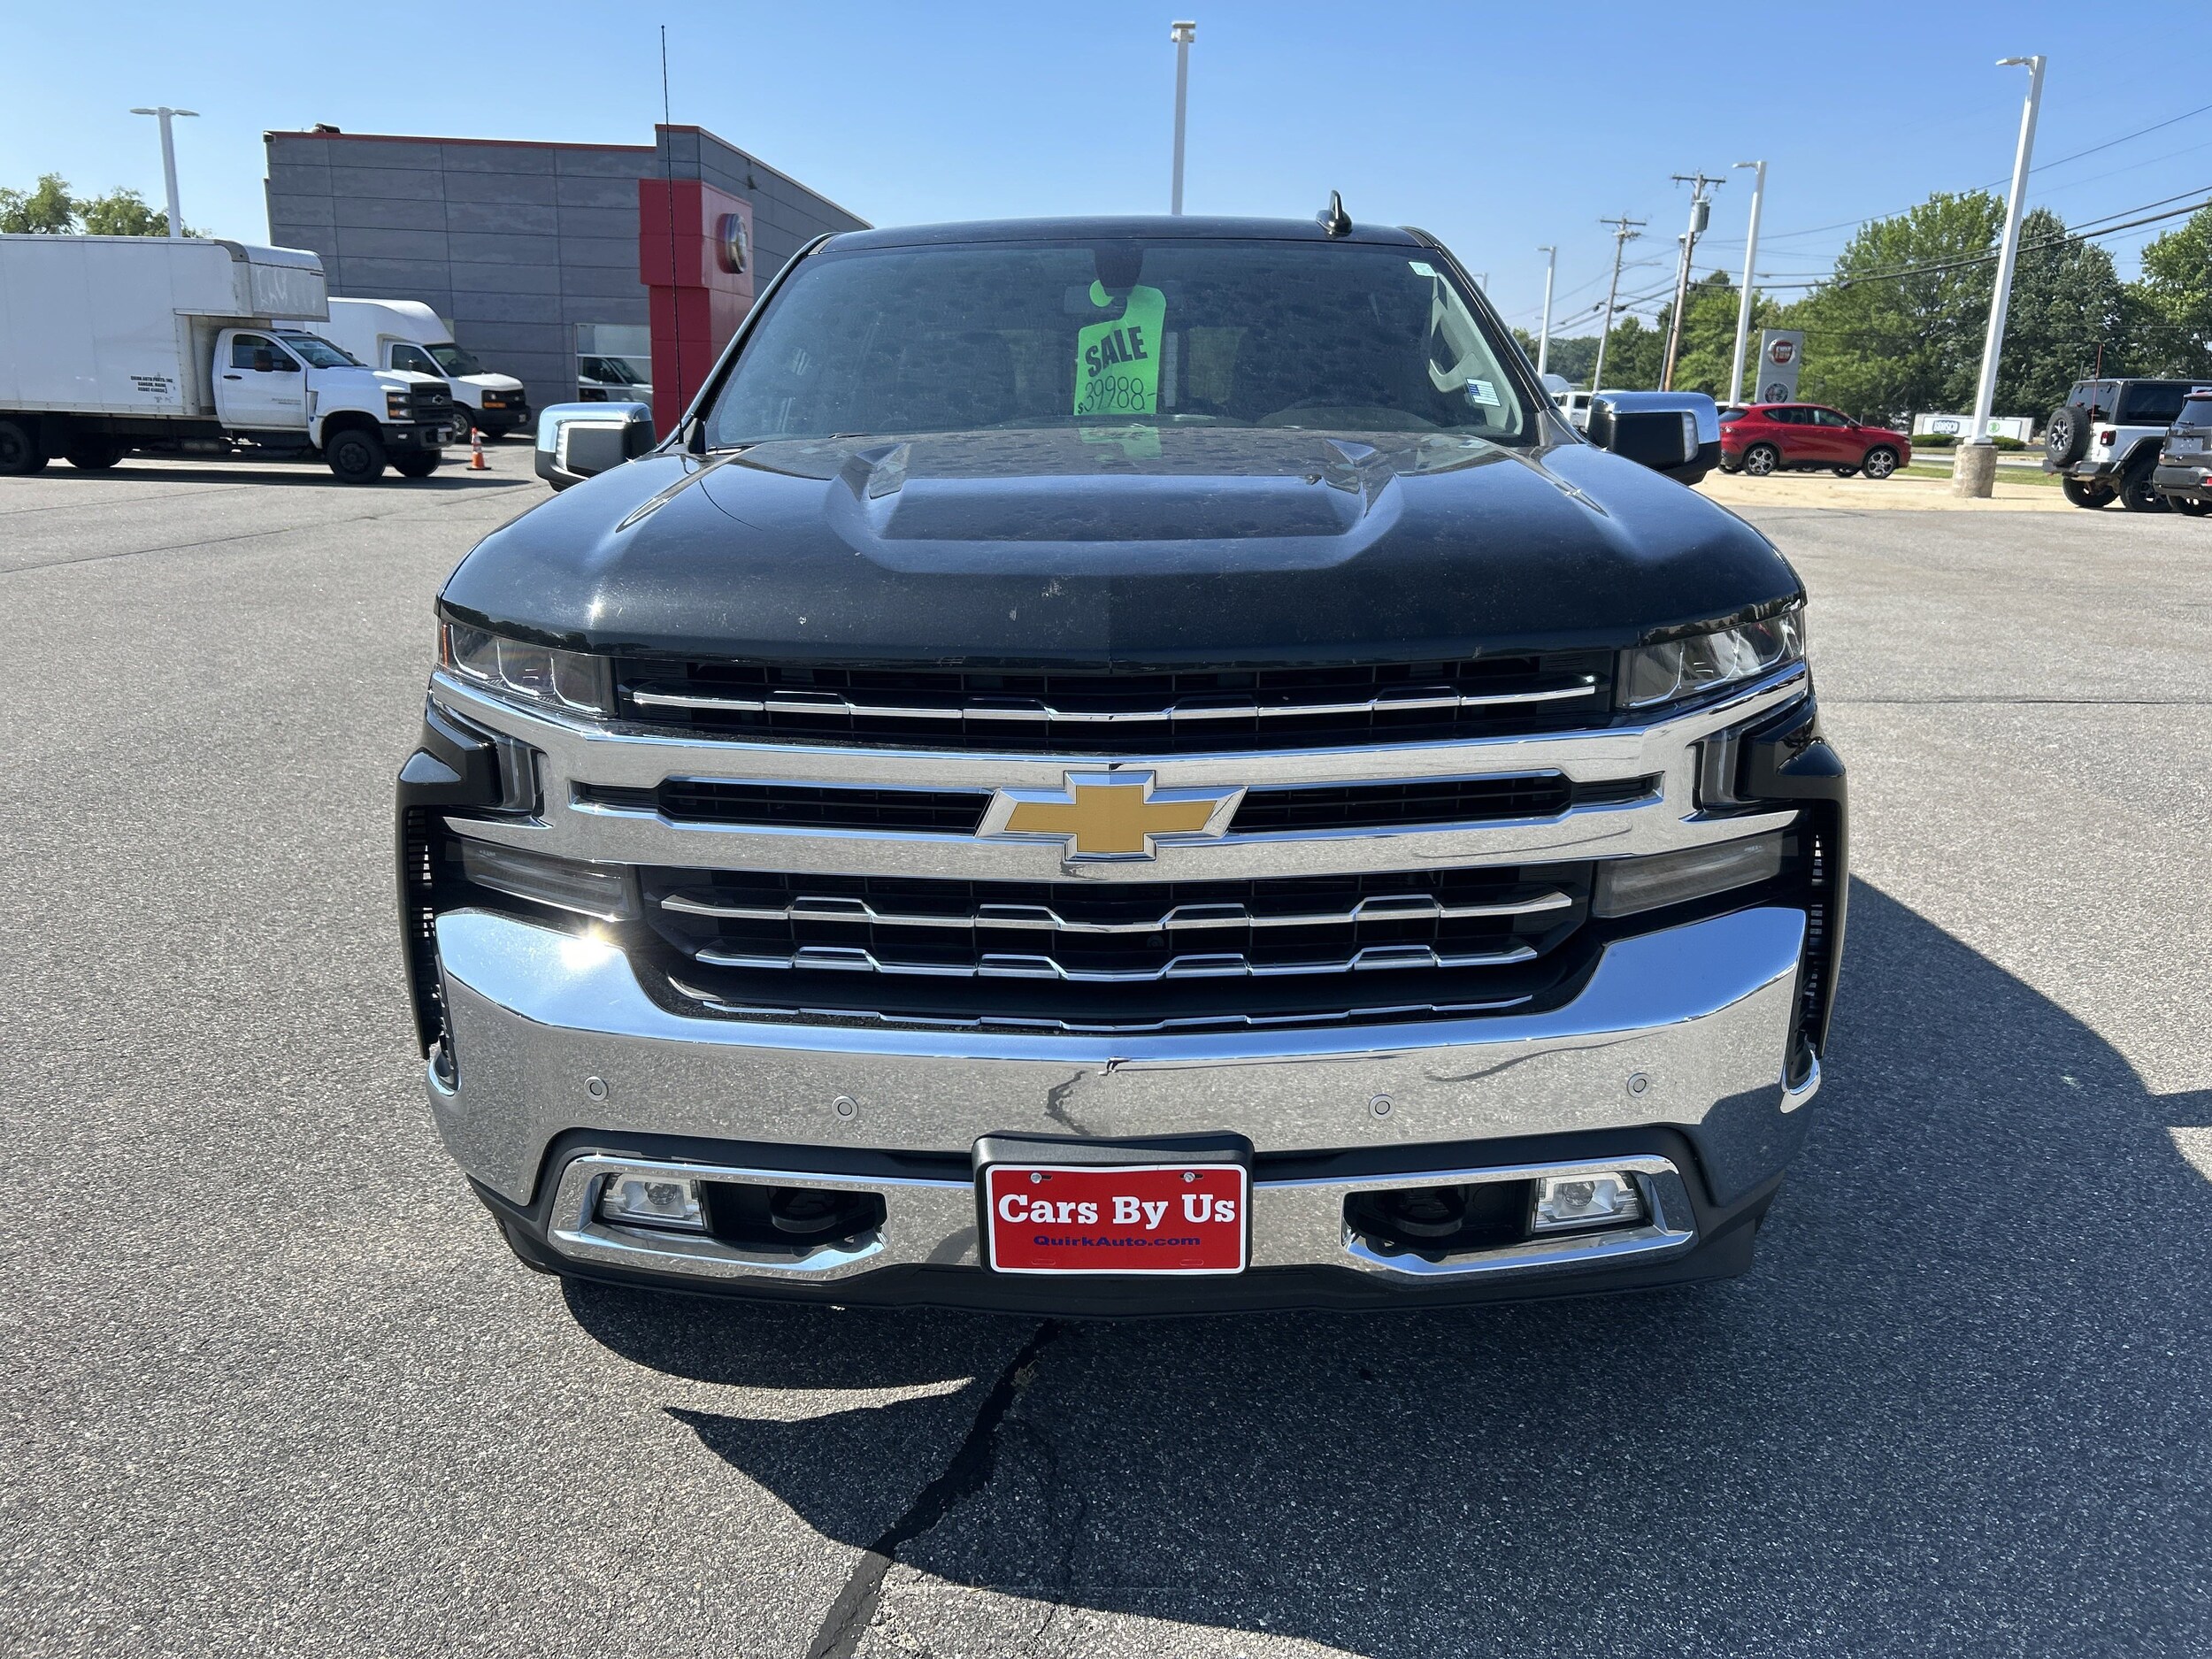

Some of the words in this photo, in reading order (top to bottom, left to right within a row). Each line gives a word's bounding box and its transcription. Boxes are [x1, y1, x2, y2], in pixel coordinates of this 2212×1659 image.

[1085, 326, 1148, 377] SALE
[998, 1194, 1099, 1225] Cars
[1112, 1196, 1169, 1230] By
[1181, 1194, 1236, 1223] Us
[1033, 1235, 1201, 1247] QuirkAuto.com
